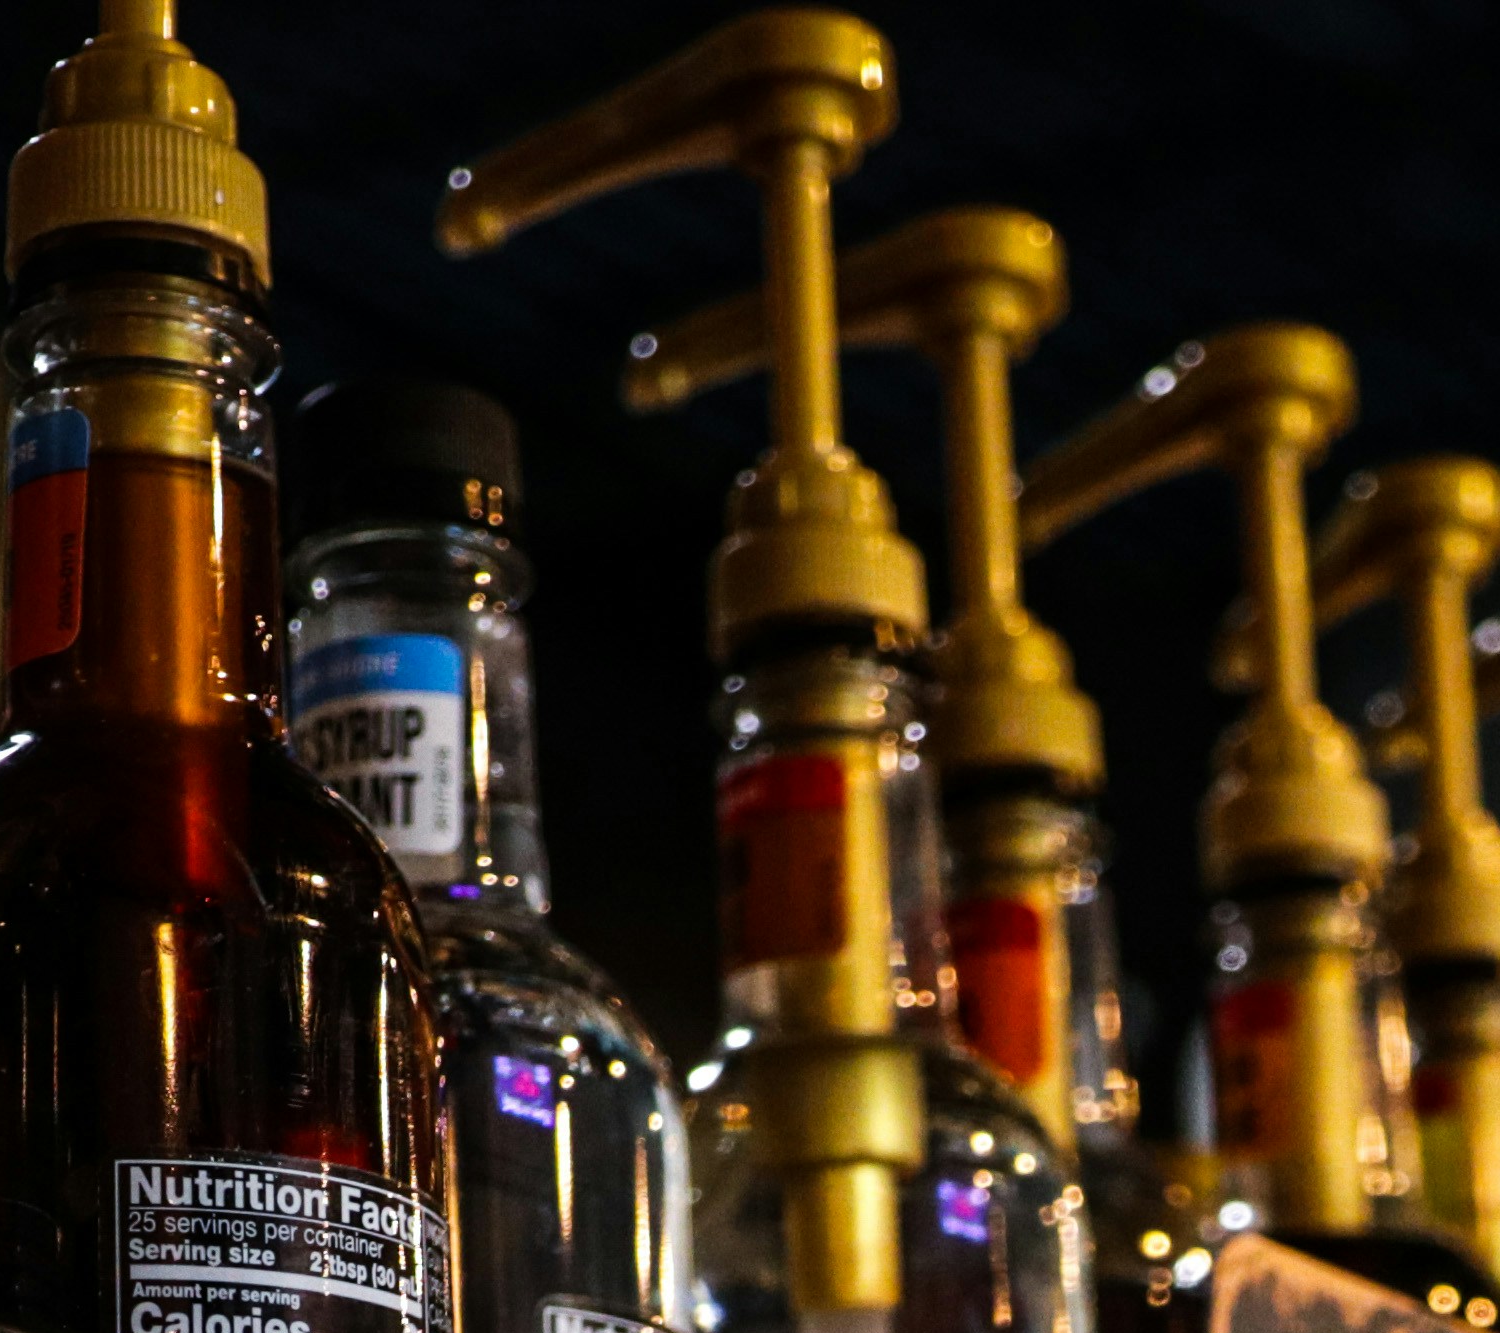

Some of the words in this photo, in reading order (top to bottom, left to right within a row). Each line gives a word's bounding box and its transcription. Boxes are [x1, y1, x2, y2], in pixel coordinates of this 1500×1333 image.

[303, 706, 425, 771] SYRUP
[129, 1166, 327, 1219] Nutrition
[340, 1185, 422, 1245] Facts
[129, 1211, 156, 1233] 25
[164, 1213, 257, 1243] servings
[264, 1223, 297, 1244] per
[303, 1225, 384, 1260] container
[129, 1238, 222, 1266] Serving
[229, 1242, 276, 1267] size
[310, 1252, 323, 1273] 2
[329, 1256, 368, 1284] tbsp
[371, 1264, 396, 1289] (30
[132, 1281, 202, 1301] Amount
[207, 1287, 236, 1304] per
[240, 1288, 301, 1311] serving
